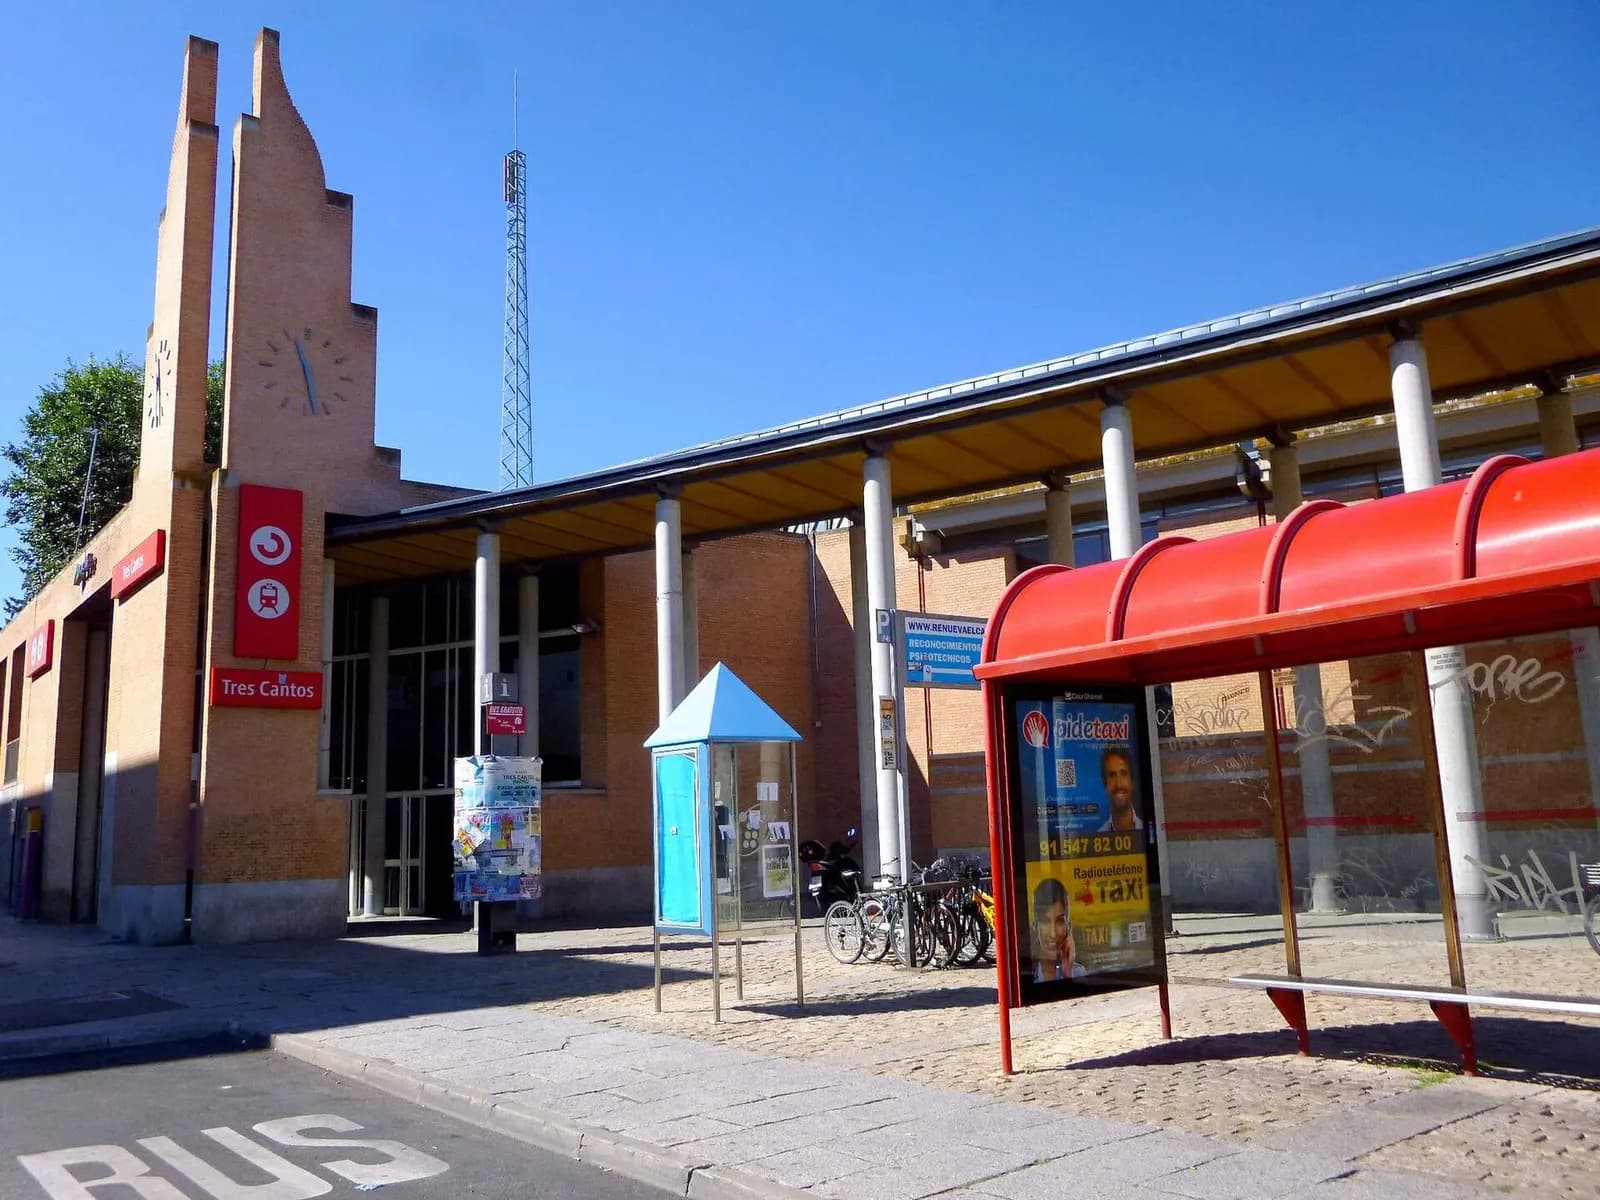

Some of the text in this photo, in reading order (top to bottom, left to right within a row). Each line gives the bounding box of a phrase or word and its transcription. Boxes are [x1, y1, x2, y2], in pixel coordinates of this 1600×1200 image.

[222, 679, 315, 698] Tres Cantos
[1054, 713, 1130, 749] pidetaxi
[1040, 835, 1132, 857] 91 547 82 00
[1085, 926, 1109, 945] TAXI
[17, 1113, 450, 1200] BUS
